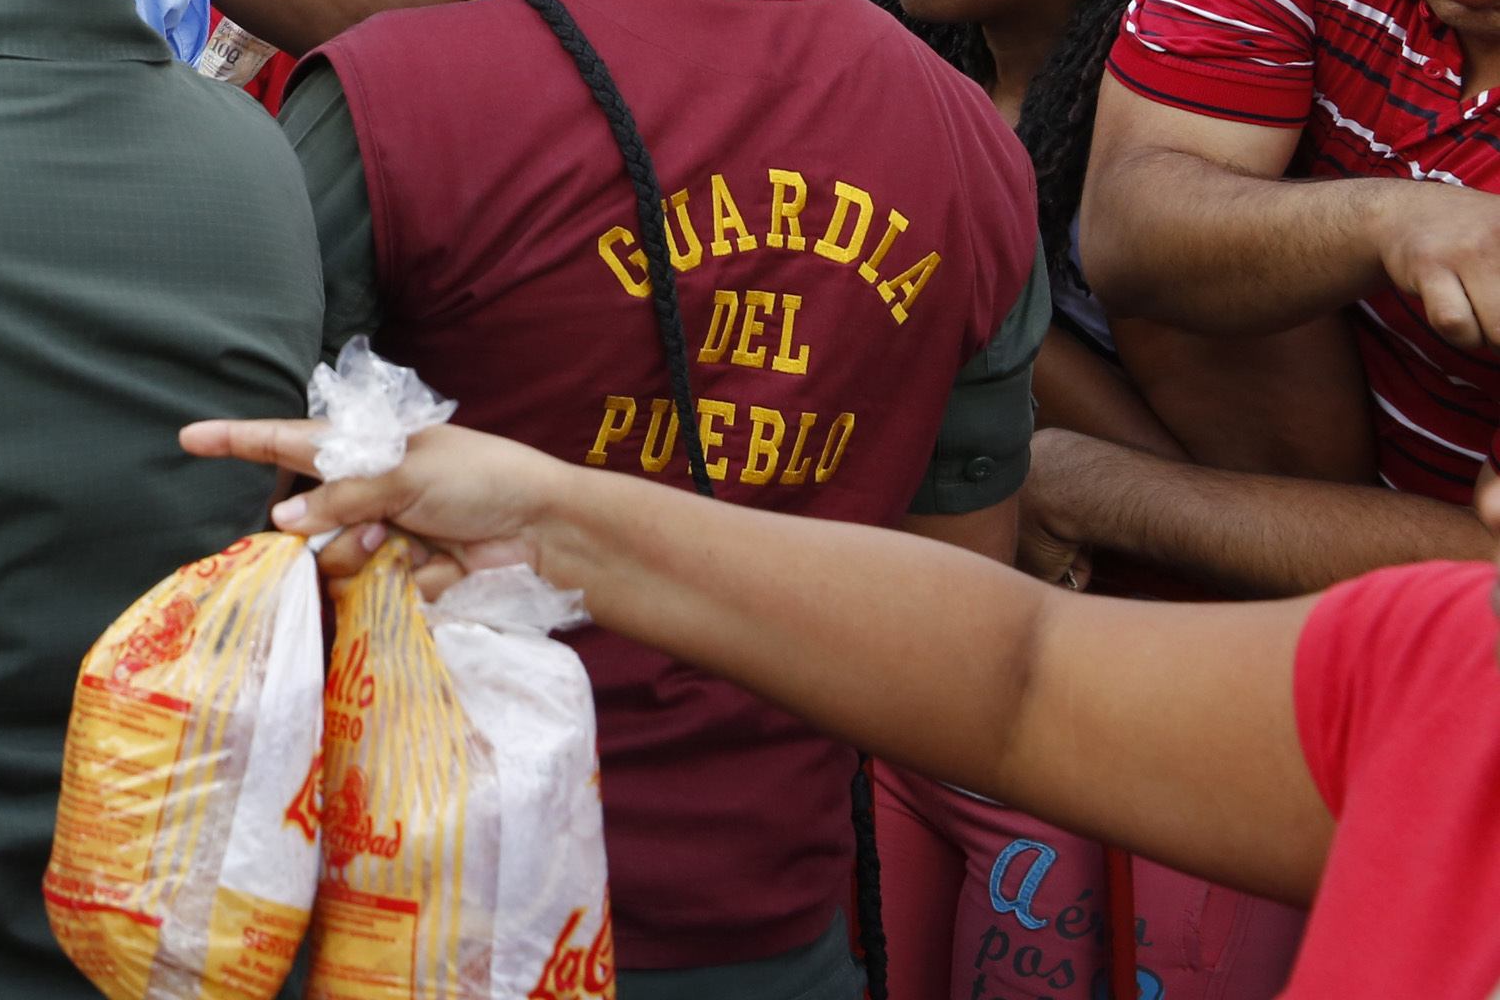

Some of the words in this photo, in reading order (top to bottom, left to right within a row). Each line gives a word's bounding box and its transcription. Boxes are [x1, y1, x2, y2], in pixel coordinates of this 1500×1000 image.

[598, 169, 940, 325] GUARDIA
[699, 290, 810, 374] DEL
[587, 397, 855, 485] PUEBLO
[973, 925, 1076, 989] pos
